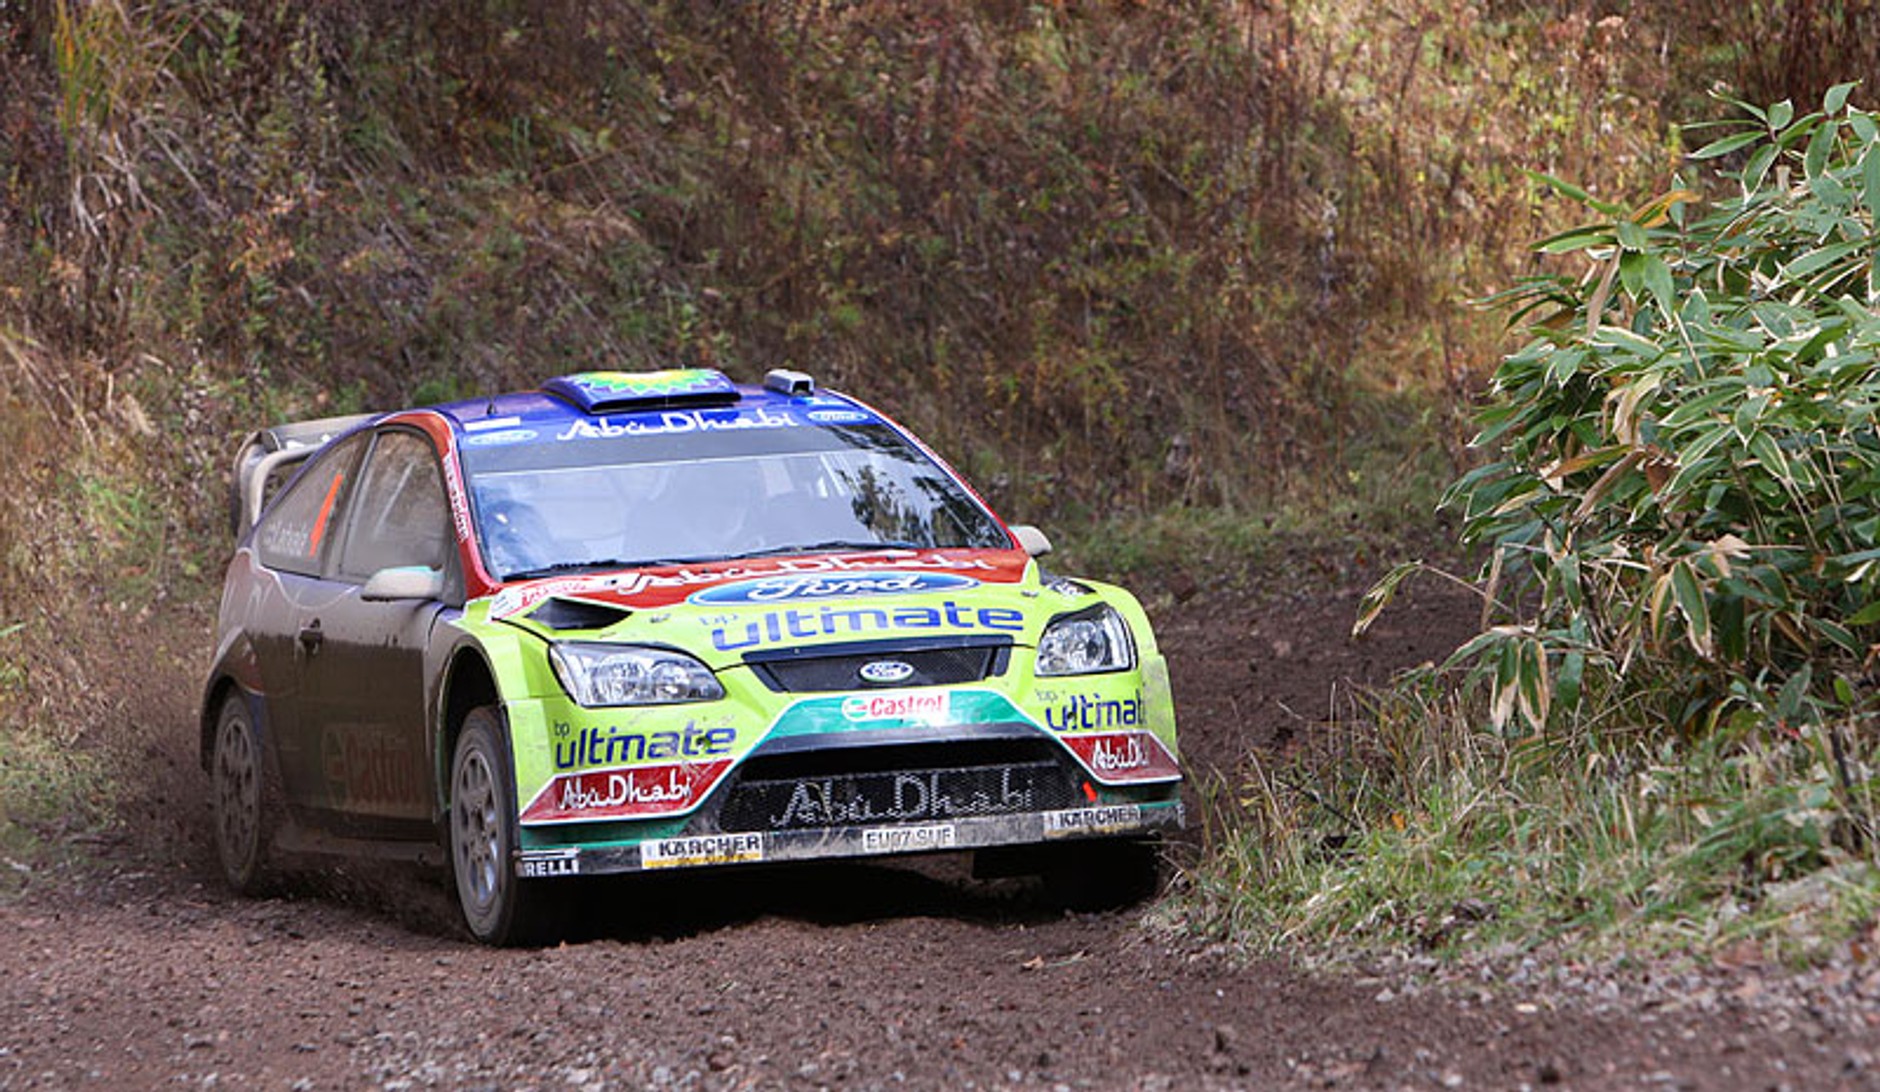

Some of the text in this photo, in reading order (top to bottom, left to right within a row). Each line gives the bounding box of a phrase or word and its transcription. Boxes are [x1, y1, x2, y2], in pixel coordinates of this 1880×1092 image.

[747, 573, 927, 599] Ford
[712, 601, 1024, 650] ultimate
[870, 694, 942, 717] Castrol
[554, 720, 570, 737] bp
[556, 720, 737, 768] ultimate
